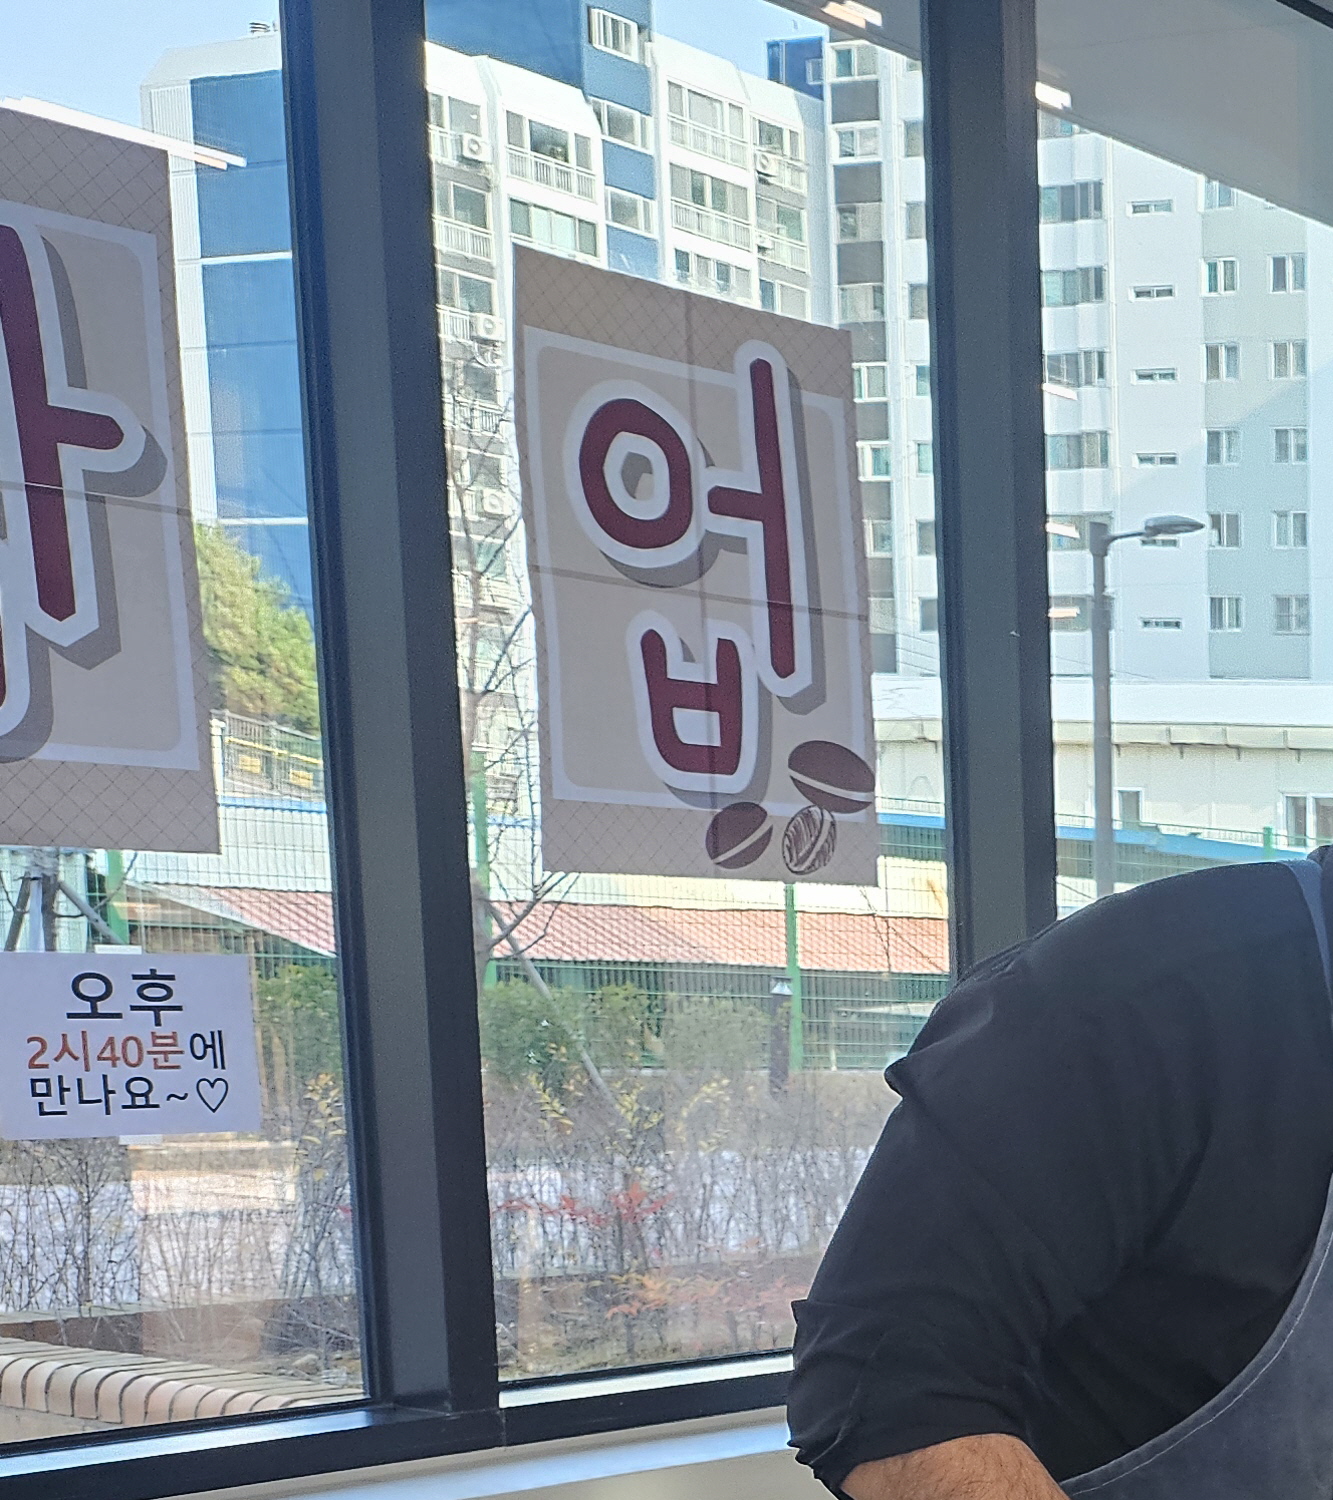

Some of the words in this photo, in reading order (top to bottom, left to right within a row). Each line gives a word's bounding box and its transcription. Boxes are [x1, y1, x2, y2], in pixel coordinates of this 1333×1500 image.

[576, 354, 800, 777] 업
[66, 968, 183, 1027] 오후
[26, 1029, 227, 1073] 2시40분에
